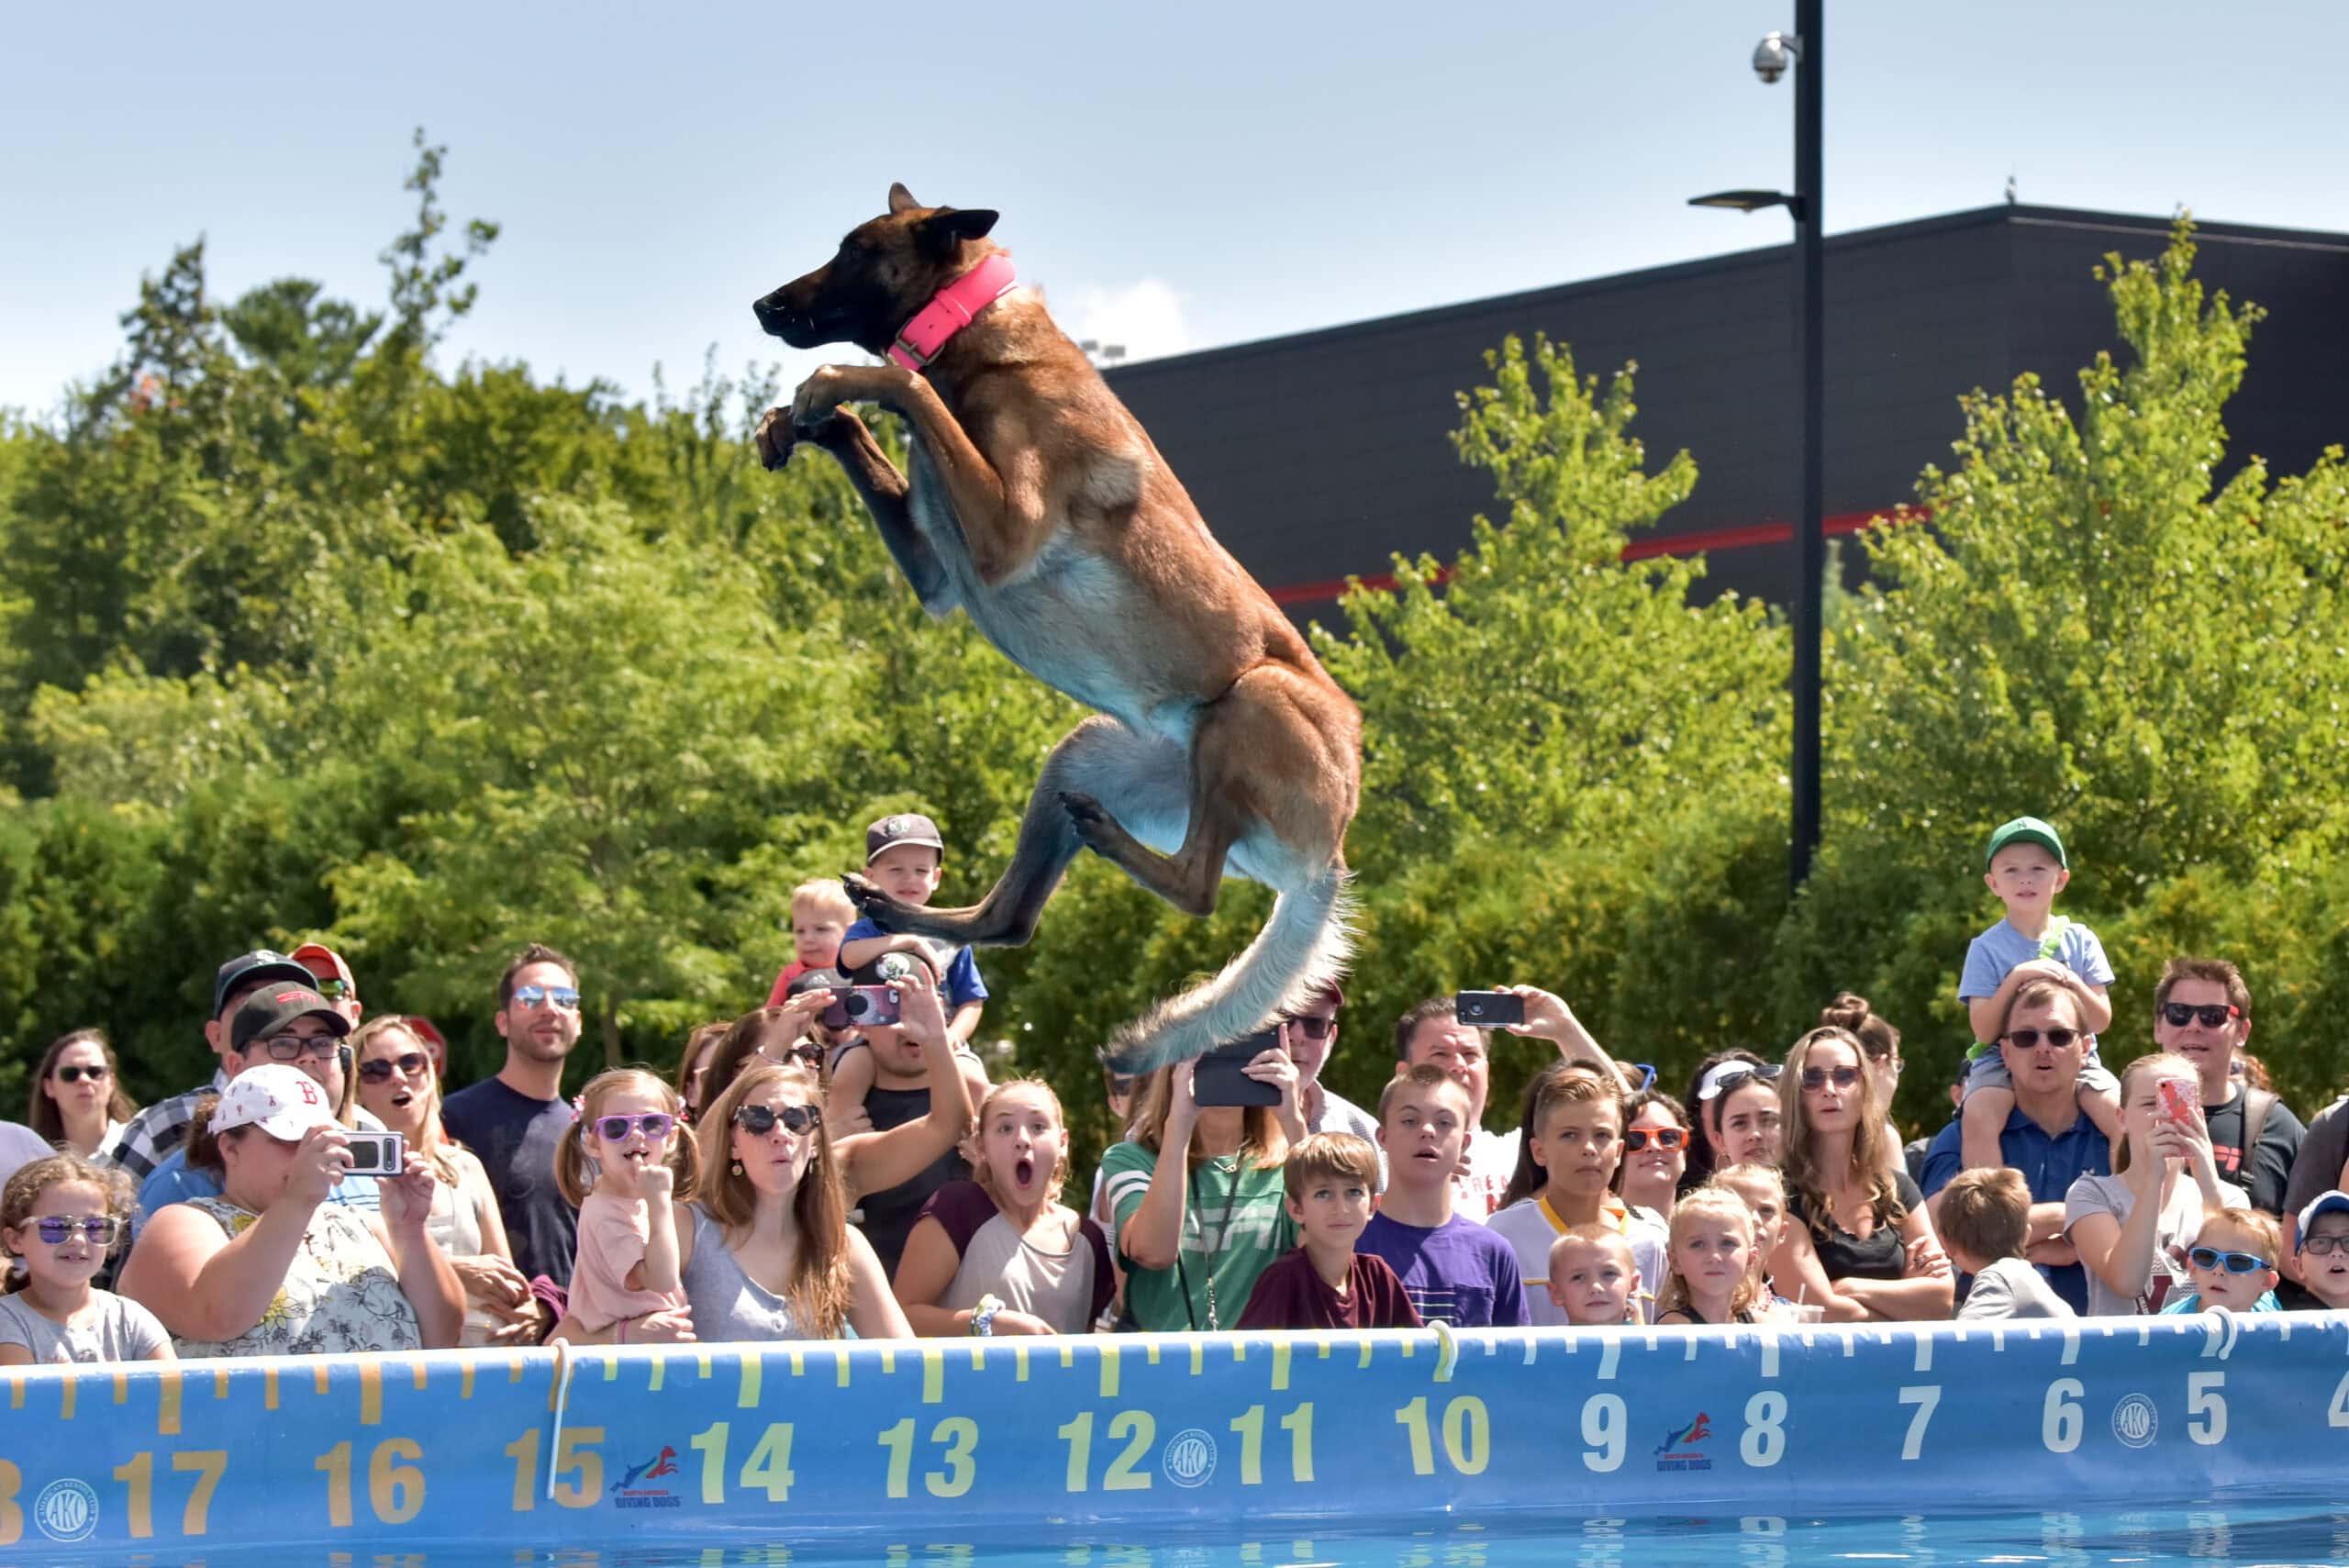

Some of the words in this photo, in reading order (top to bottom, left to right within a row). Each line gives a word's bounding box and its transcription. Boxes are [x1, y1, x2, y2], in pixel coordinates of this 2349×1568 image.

[295, 1081, 317, 1105] B
[1230, 1402, 1314, 1485] 11
[1395, 1396, 1490, 1476] 10
[1581, 1393, 1627, 1473] 9
[1740, 1391, 1787, 1467] 8
[1898, 1385, 1941, 1460] 7
[2043, 1378, 2084, 1453] 6
[2188, 1371, 2227, 1446] 5
[315, 1438, 426, 1527] 16
[506, 1427, 605, 1511] 15
[690, 1422, 794, 1504] 14
[878, 1417, 978, 1498] 13
[1058, 1410, 1155, 1492] 12
[46, 1489, 88, 1532] AKC
[114, 1450, 228, 1539] 17
[614, 1496, 651, 1508] DIVING
